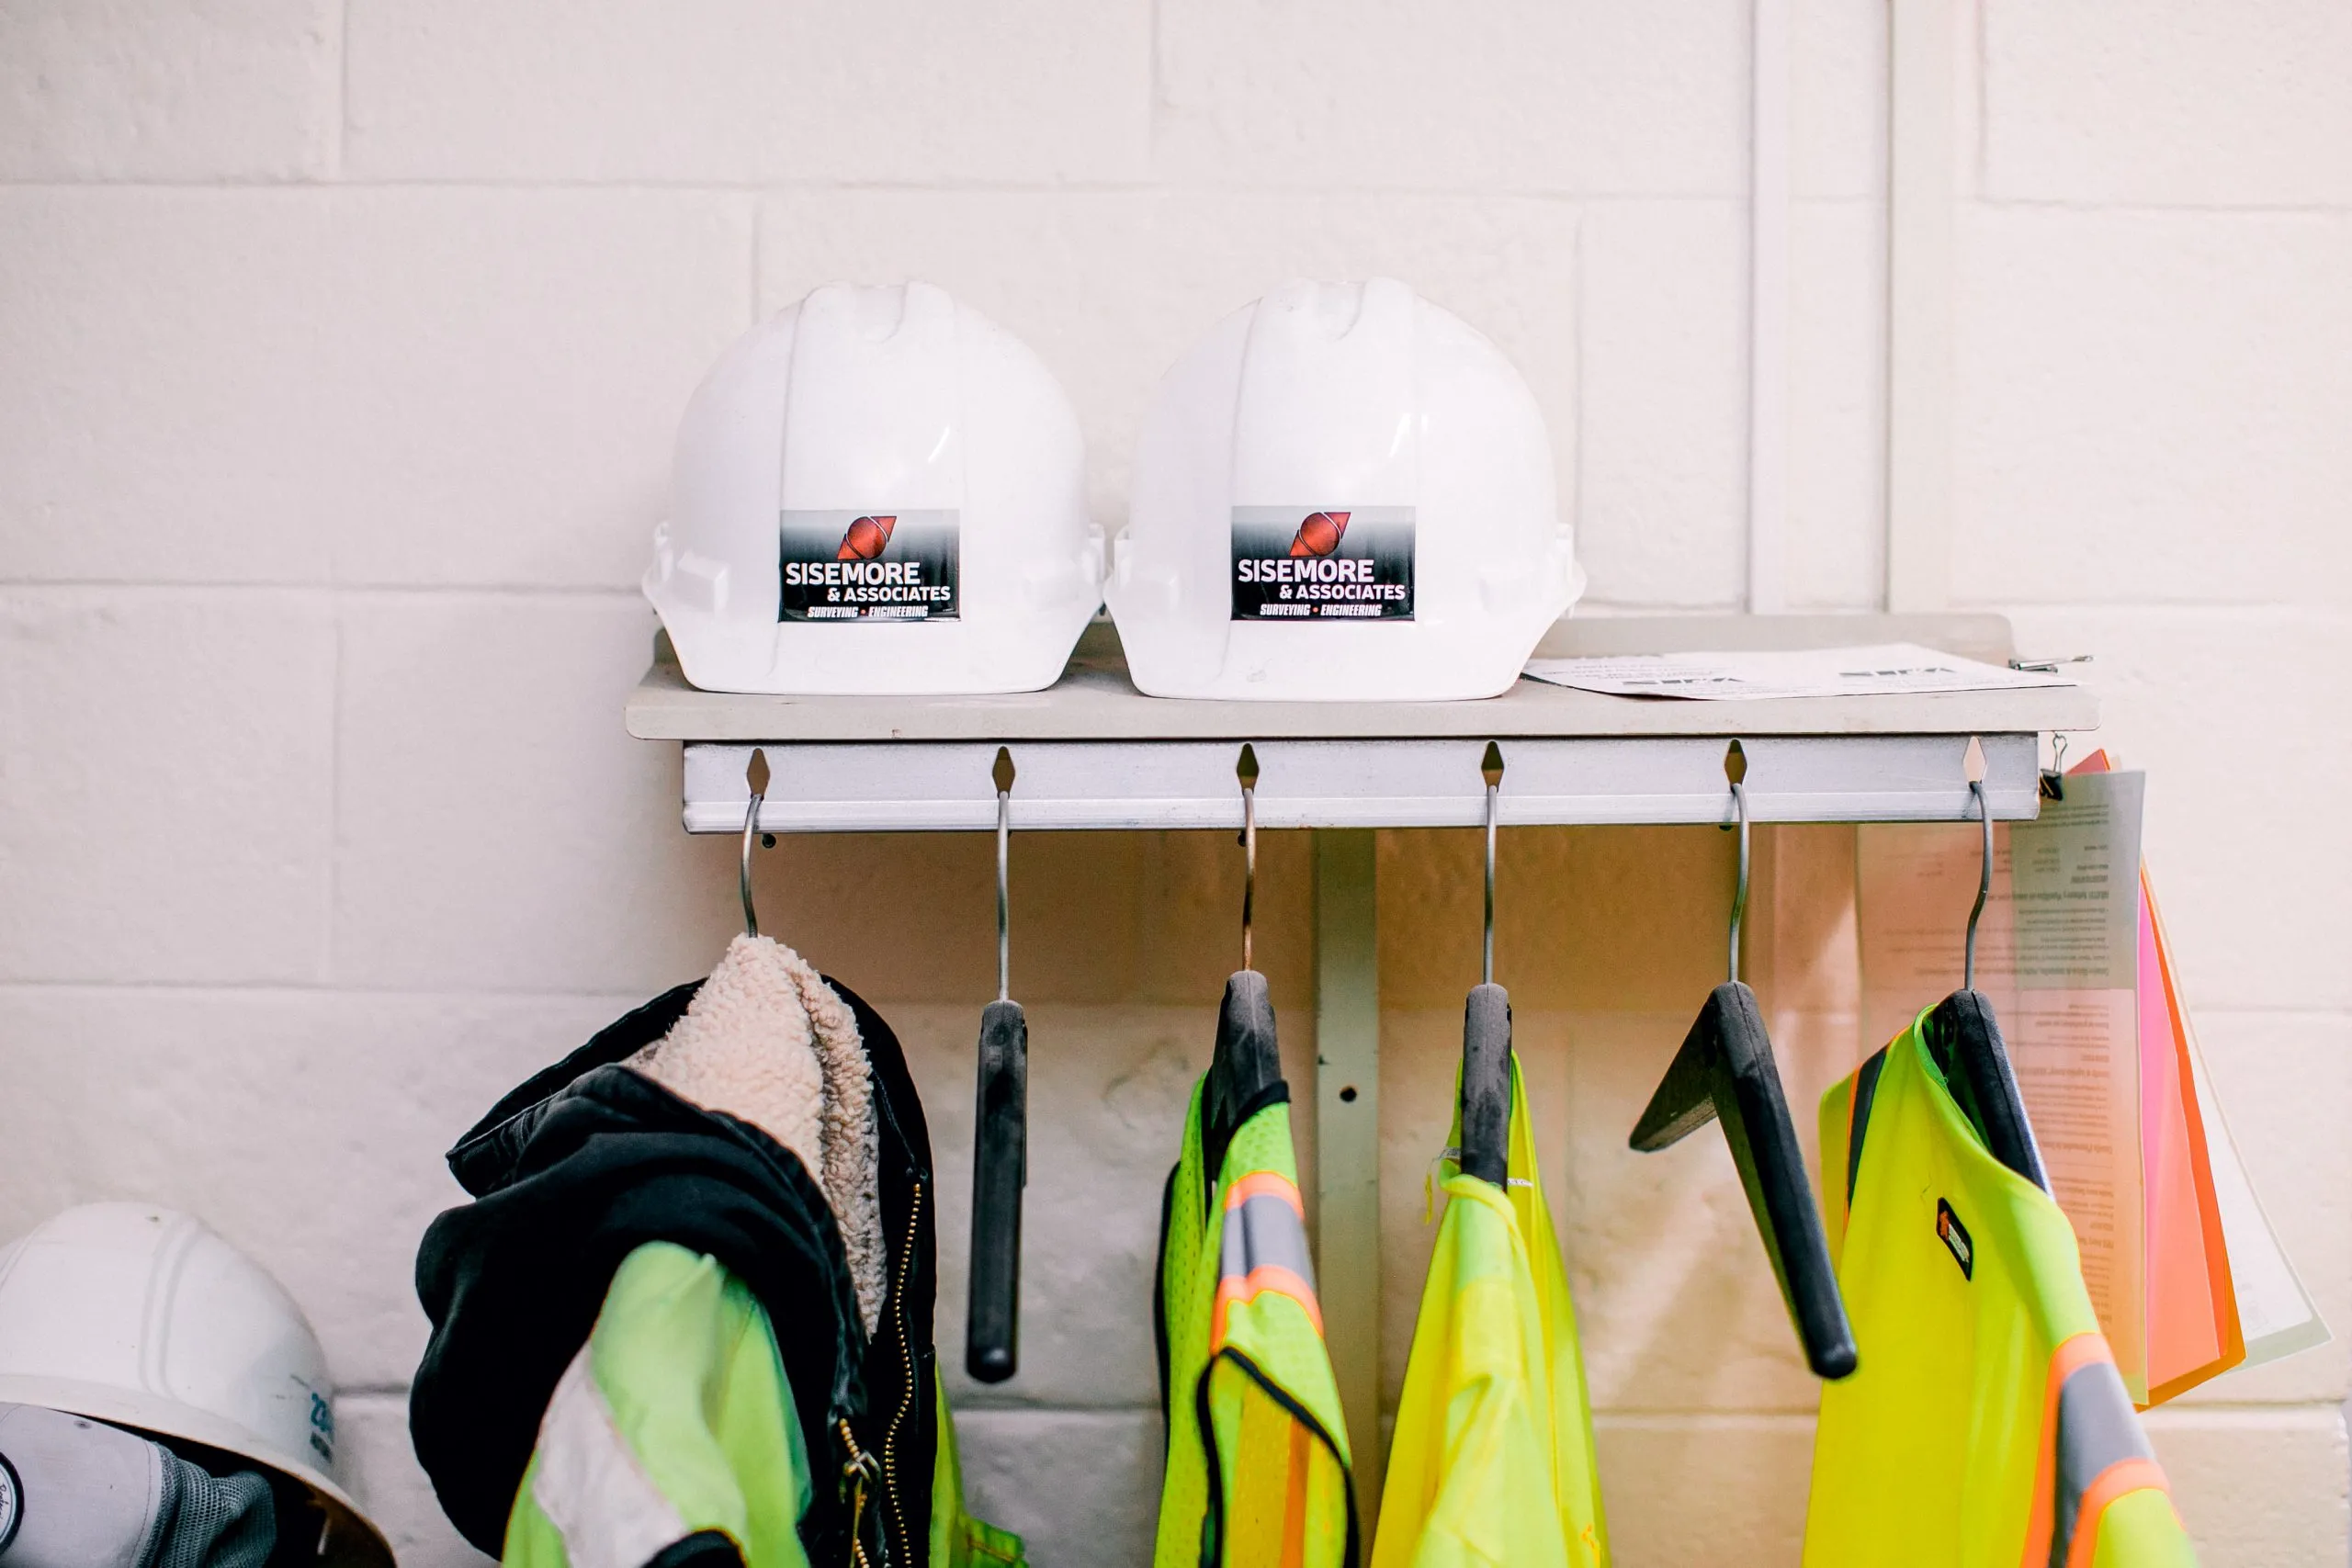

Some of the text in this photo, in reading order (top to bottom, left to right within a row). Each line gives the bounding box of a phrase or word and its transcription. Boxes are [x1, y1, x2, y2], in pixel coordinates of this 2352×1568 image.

[786, 561, 921, 585] SISEMORE
[1238, 558, 1374, 582] SISEMORE
[827, 586, 951, 602] & ASSOCIATES
[1279, 584, 1406, 600] & ASSOCIATES
[807, 605, 929, 618] SURVEYING ENGINEERING
[1260, 604, 1383, 616] SURVEYING ENGINEERING
